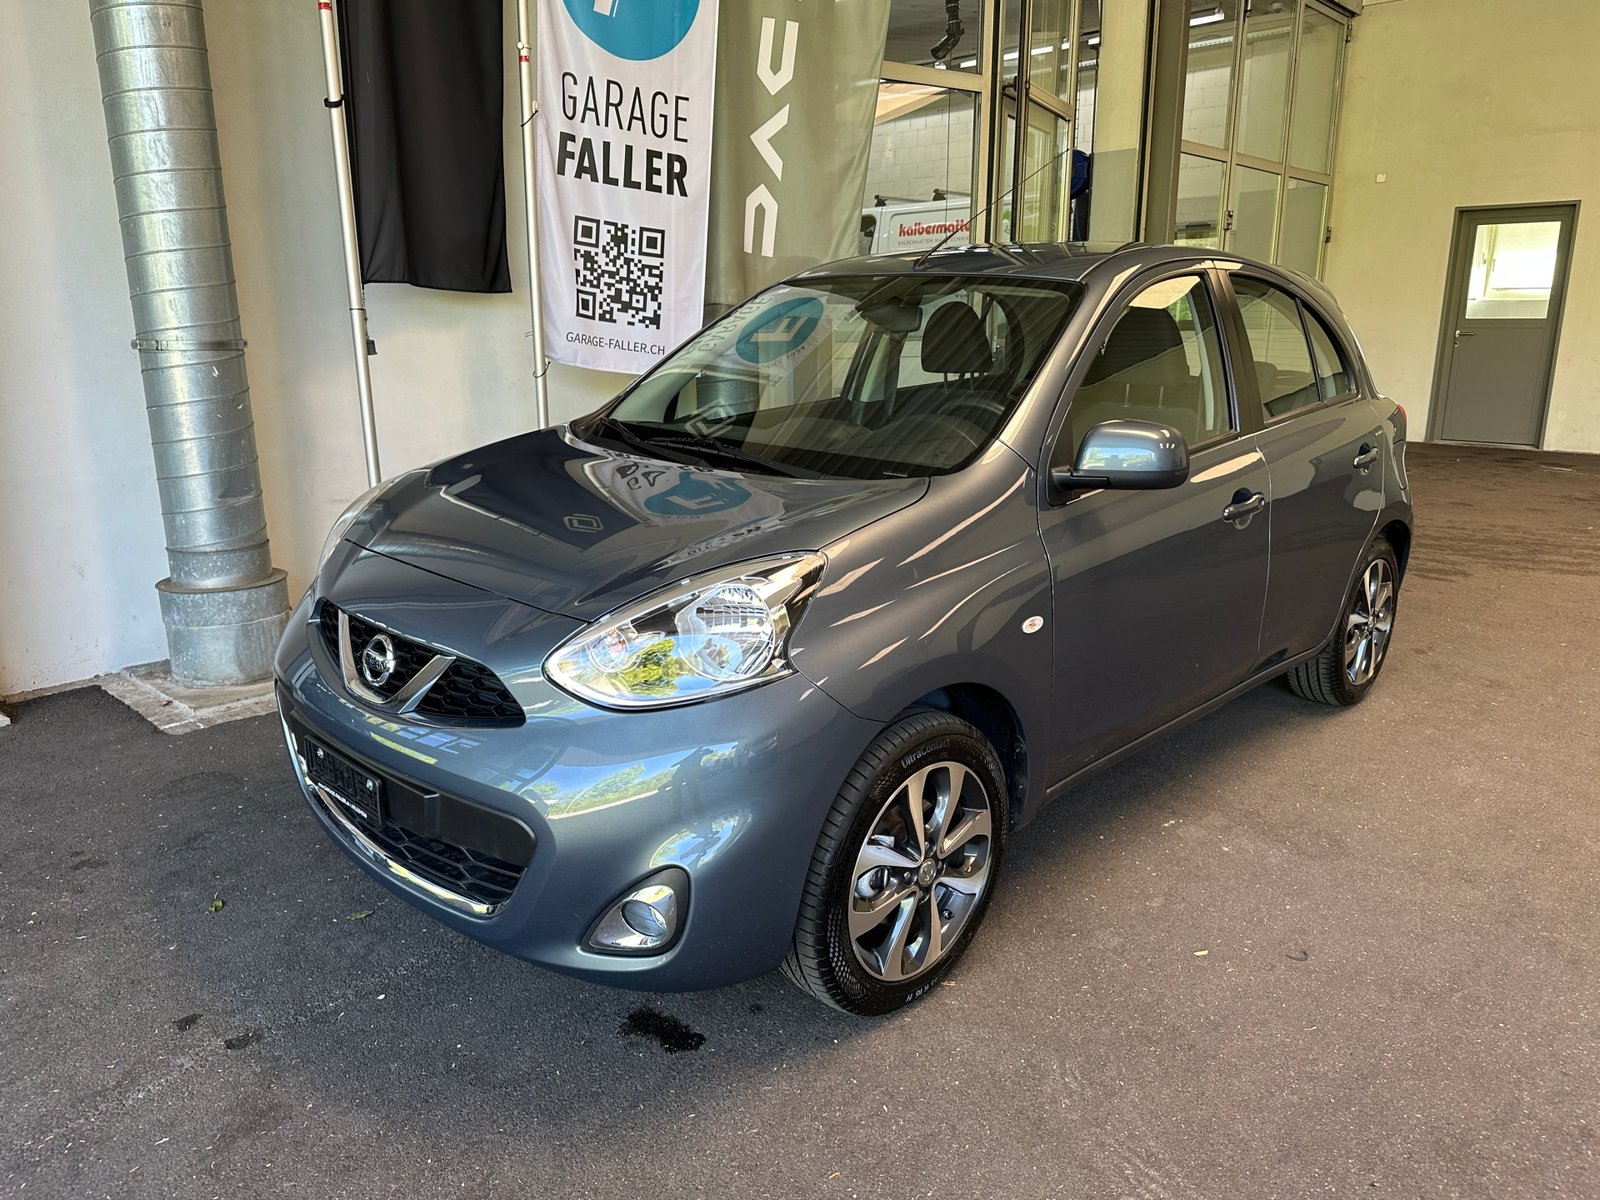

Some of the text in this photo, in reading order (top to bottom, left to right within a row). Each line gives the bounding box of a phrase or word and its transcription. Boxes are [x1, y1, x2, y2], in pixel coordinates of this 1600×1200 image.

[560, 71, 690, 144] GARAGE
[744, 16, 800, 258] DAC
[556, 131, 689, 198] FALLER
[565, 331, 666, 356] GARAGE-FALLER.CH
